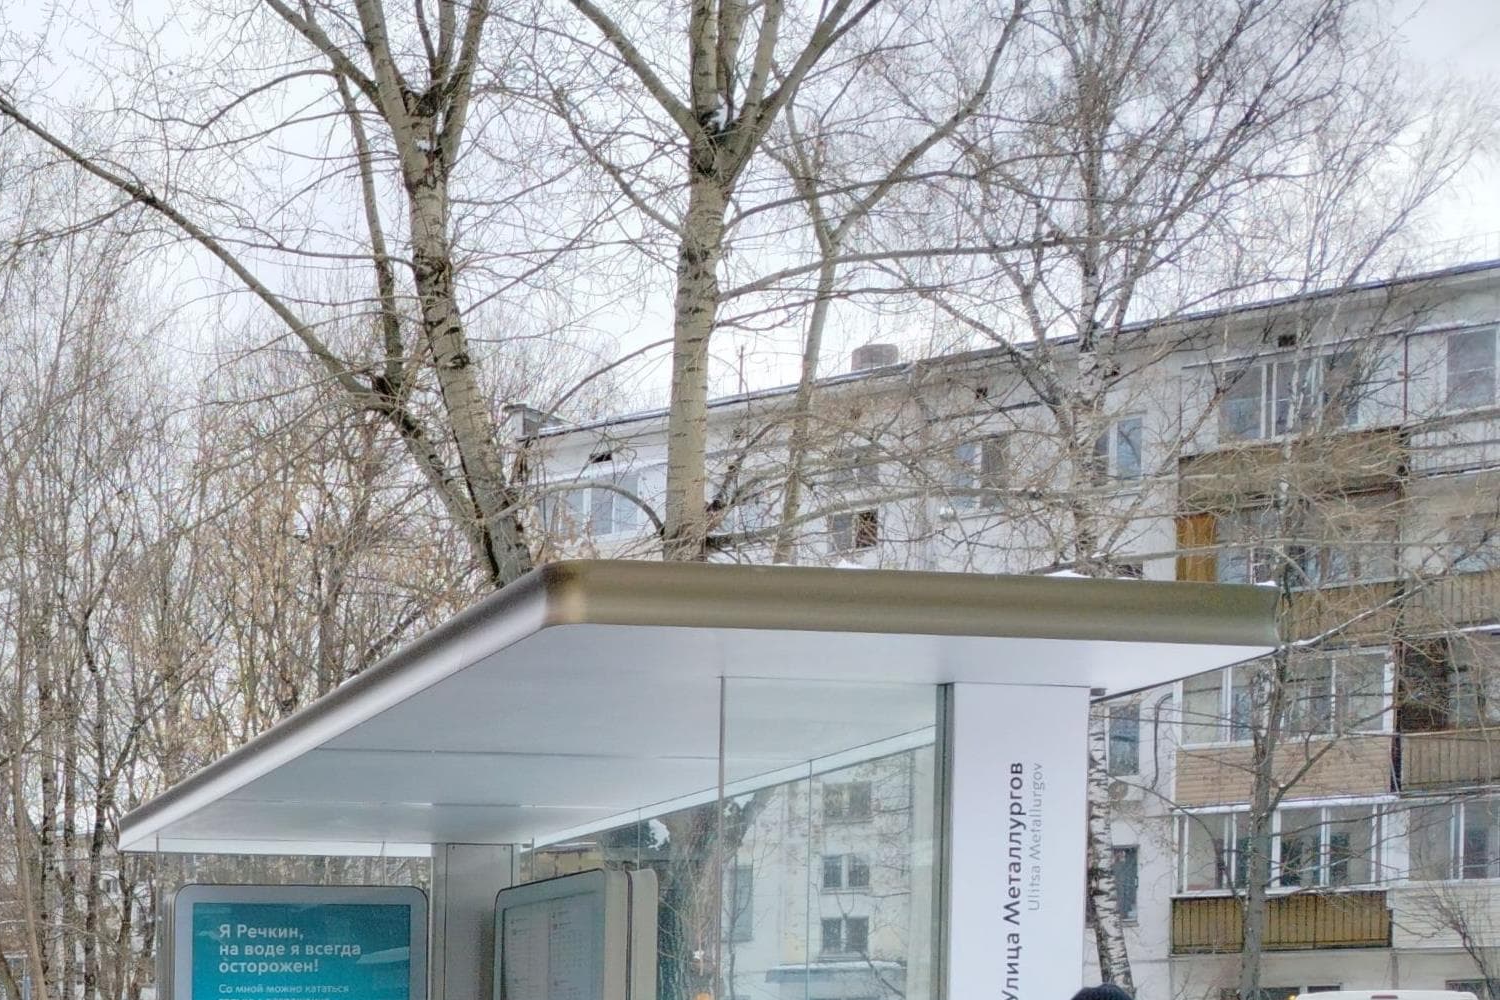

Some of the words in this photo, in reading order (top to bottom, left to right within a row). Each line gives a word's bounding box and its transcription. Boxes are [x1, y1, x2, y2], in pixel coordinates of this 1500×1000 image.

[1028, 762, 1045, 860] Metallurgov
[1002, 762, 1026, 925] Металлургов
[1028, 865, 1041, 911] Ulitsa
[219, 924, 231, 938] Я
[237, 924, 304, 940] Речкин,
[219, 945, 239, 956] на
[244, 945, 285, 957] воде
[291, 945, 300, 956] я
[305, 944, 362, 957] всегда
[219, 959, 319, 975] осторожен!
[219, 984, 233, 993] Со
[235, 983, 263, 993] мной
[266, 985, 302, 993] можно
[305, 985, 349, 993] кататься
